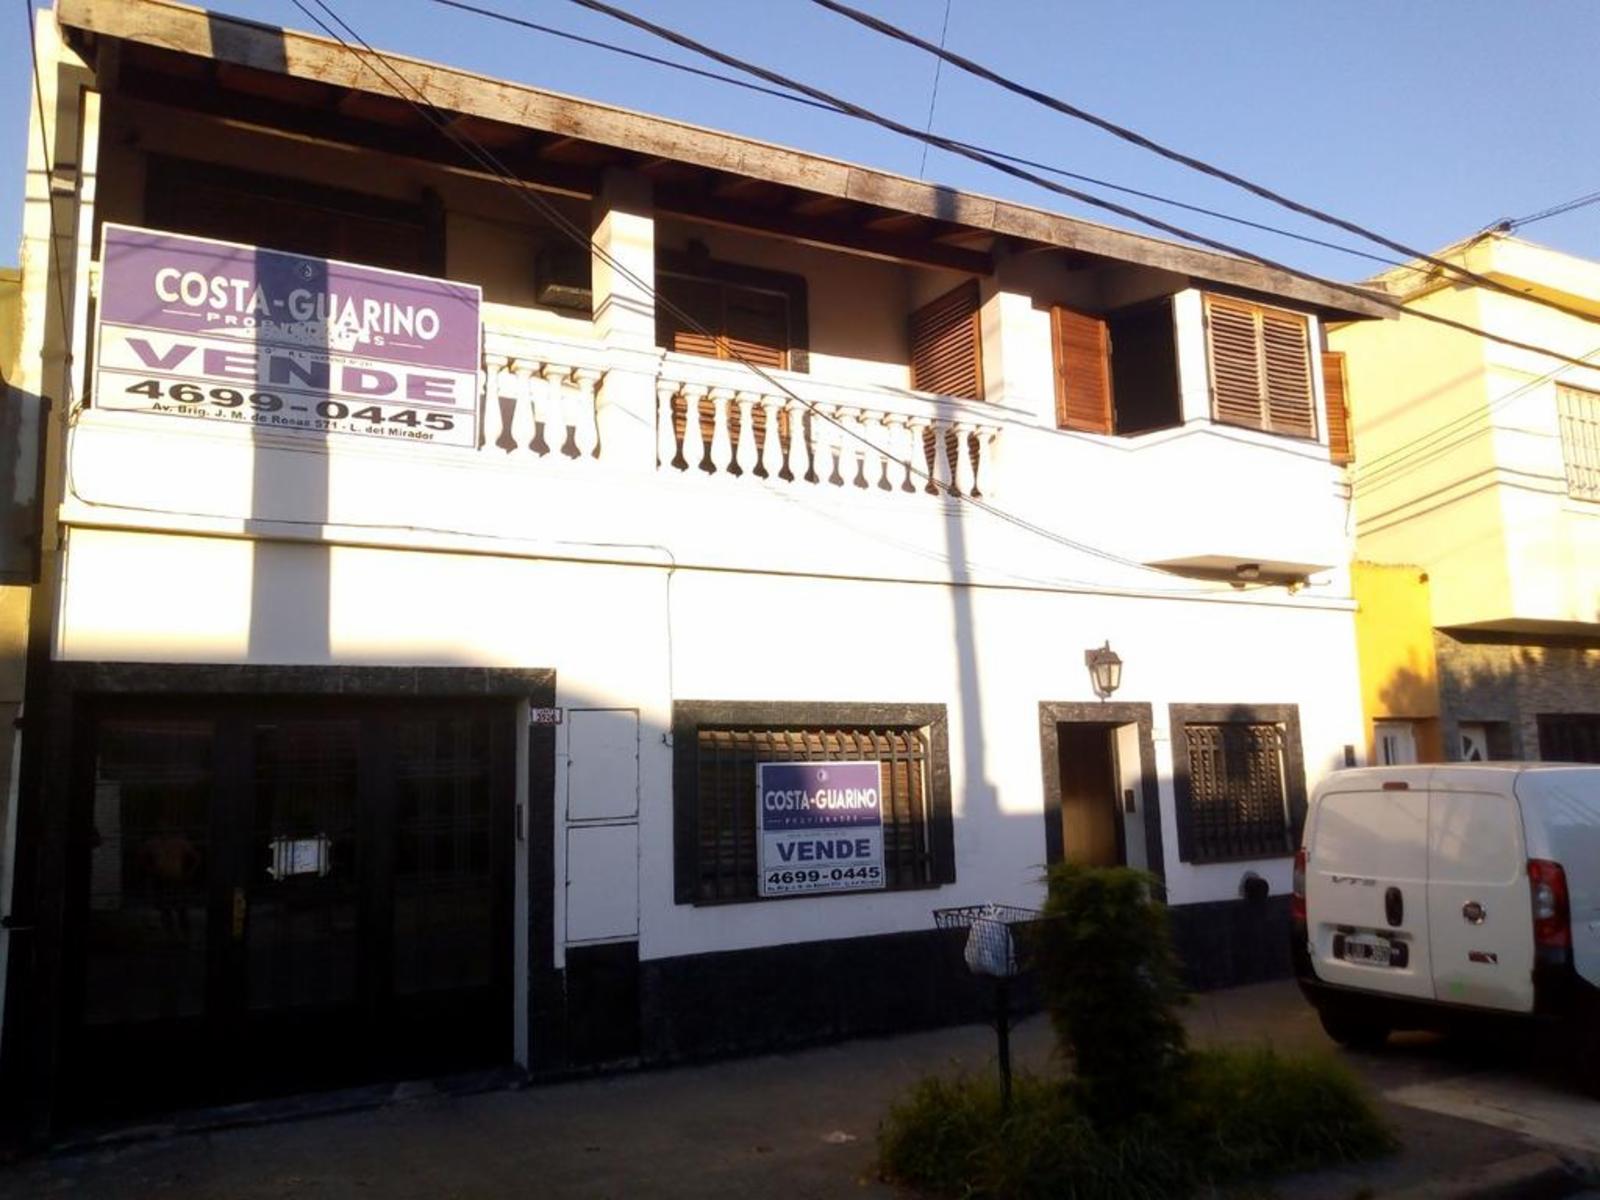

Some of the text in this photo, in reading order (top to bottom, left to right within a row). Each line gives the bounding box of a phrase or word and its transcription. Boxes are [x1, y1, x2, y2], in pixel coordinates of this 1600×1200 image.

[155, 267, 440, 340] COSTA-GUARINO
[125, 337, 456, 405] VENDE
[125, 379, 455, 431] 4699-0445
[152, 402, 172, 412] Av.
[178, 404, 210, 418] Brig.
[215, 408, 226, 418] J.
[231, 411, 246, 420] M.
[252, 413, 267, 422] de
[271, 415, 310, 427] Rosas
[350, 423, 361, 432] L.
[365, 425, 384, 435] del
[388, 428, 434, 440] Mirador
[765, 788, 878, 811] COSTA-GUARINO
[776, 838, 871, 863] VENDE
[768, 866, 880, 884] 4699-0445
